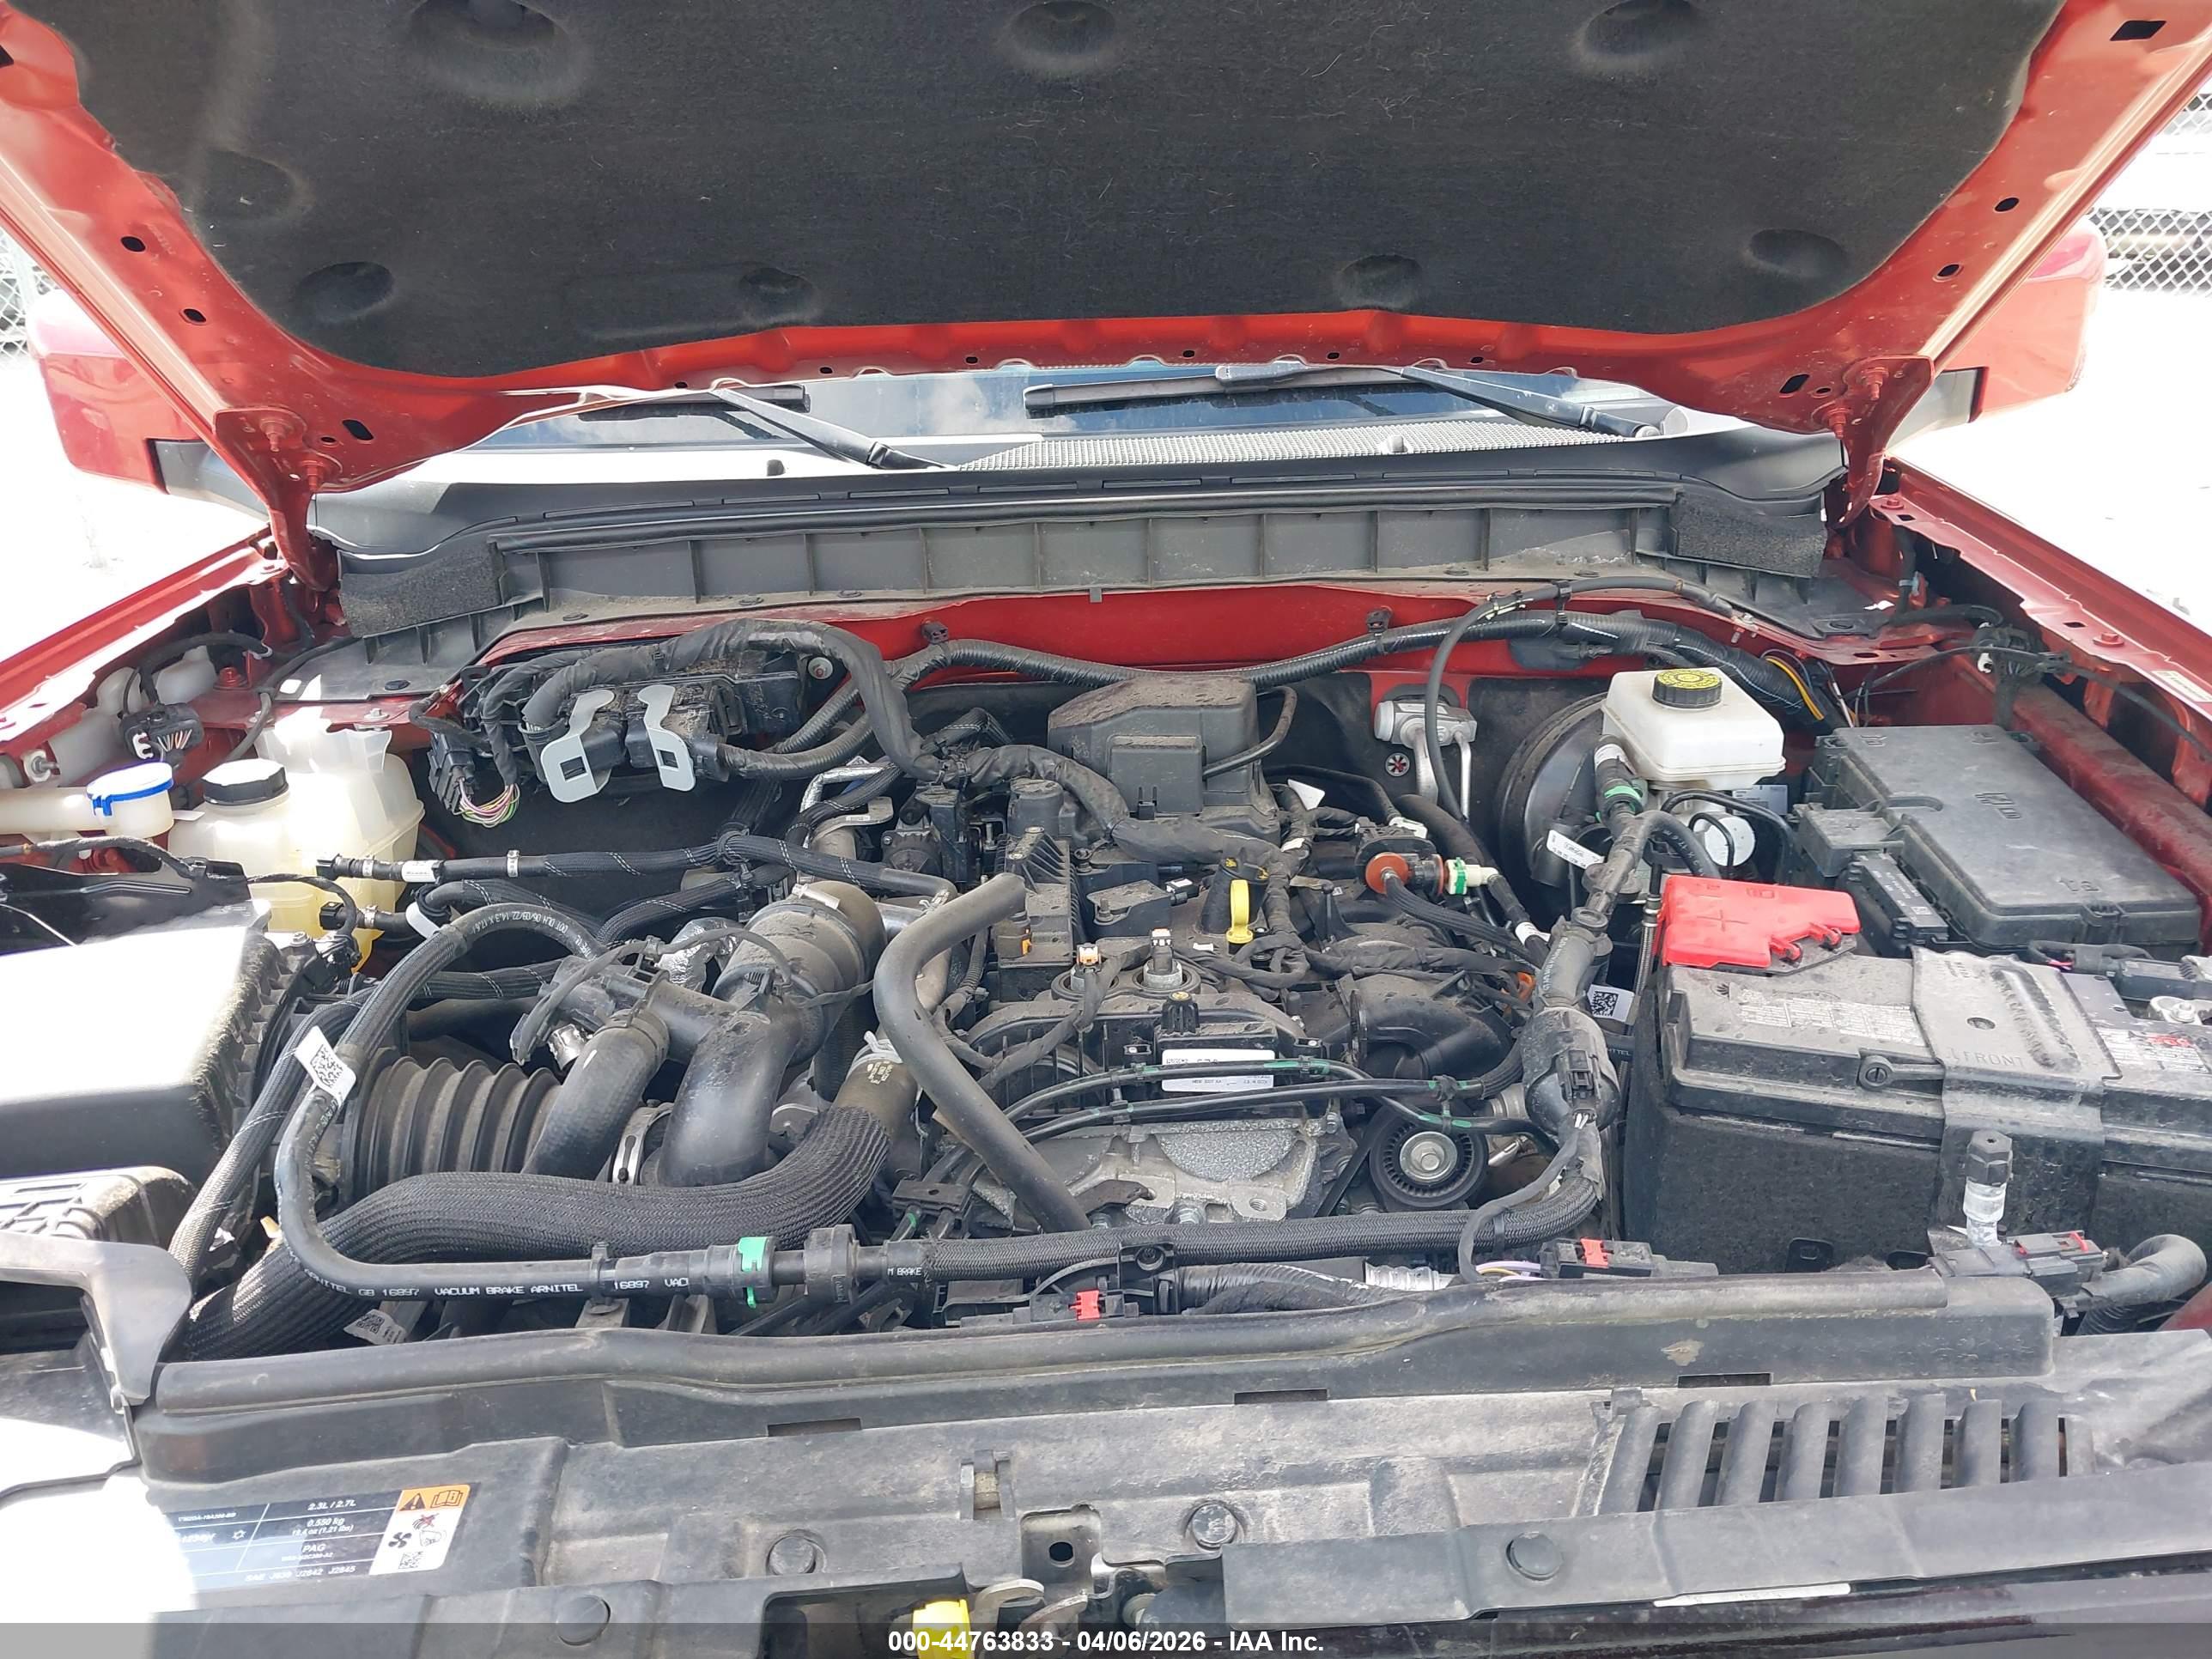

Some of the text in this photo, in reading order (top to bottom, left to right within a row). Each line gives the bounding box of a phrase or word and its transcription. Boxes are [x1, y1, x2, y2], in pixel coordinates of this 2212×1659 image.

[896, 1267, 922, 1276] BRAKE
[613, 1277, 689, 1290] 16897 VAC
[434, 1287, 480, 1297] VACUUM
[486, 1285, 525, 1296] BRAKE
[530, 1283, 585, 1294] ARNITEL
[307, 1502, 328, 1511] 2.3L
[336, 1499, 357, 1509] 2.7L
[301, 1543, 326, 1553] PAG
